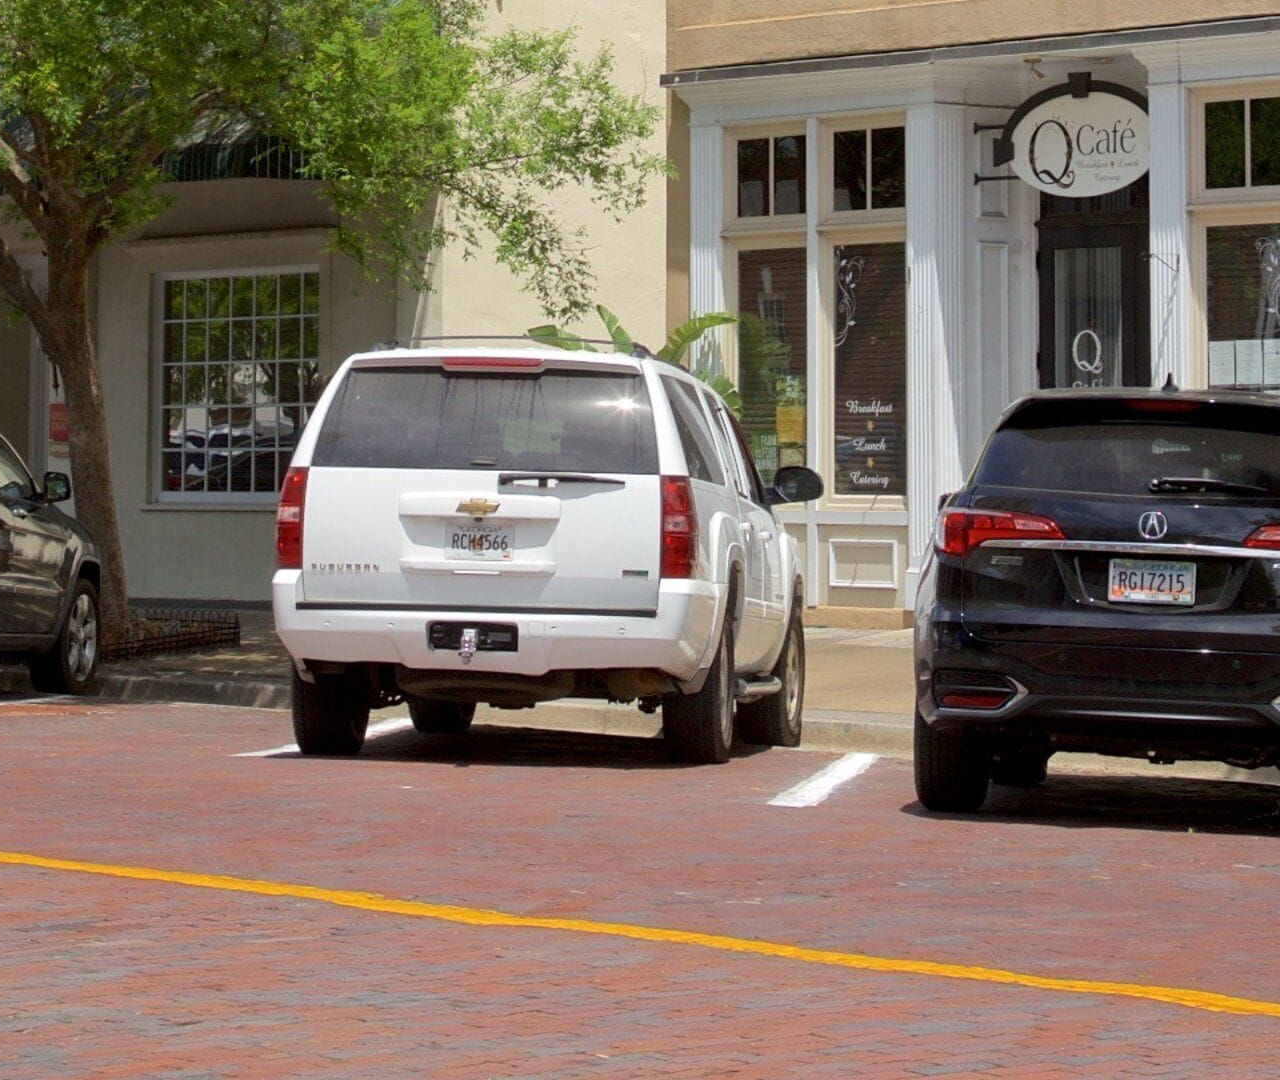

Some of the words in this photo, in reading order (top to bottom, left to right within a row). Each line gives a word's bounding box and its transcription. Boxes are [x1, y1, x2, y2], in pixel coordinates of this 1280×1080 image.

[1028, 119, 1075, 189] Q
[1076, 118, 1136, 157] Café
[1072, 330, 1103, 374] Q
[845, 400, 894, 418] Breakfast
[852, 437, 887, 451] Lunch
[849, 470, 890, 488] Catering
[451, 532, 508, 551] RCH4566
[311, 563, 380, 571] SUBURBAN
